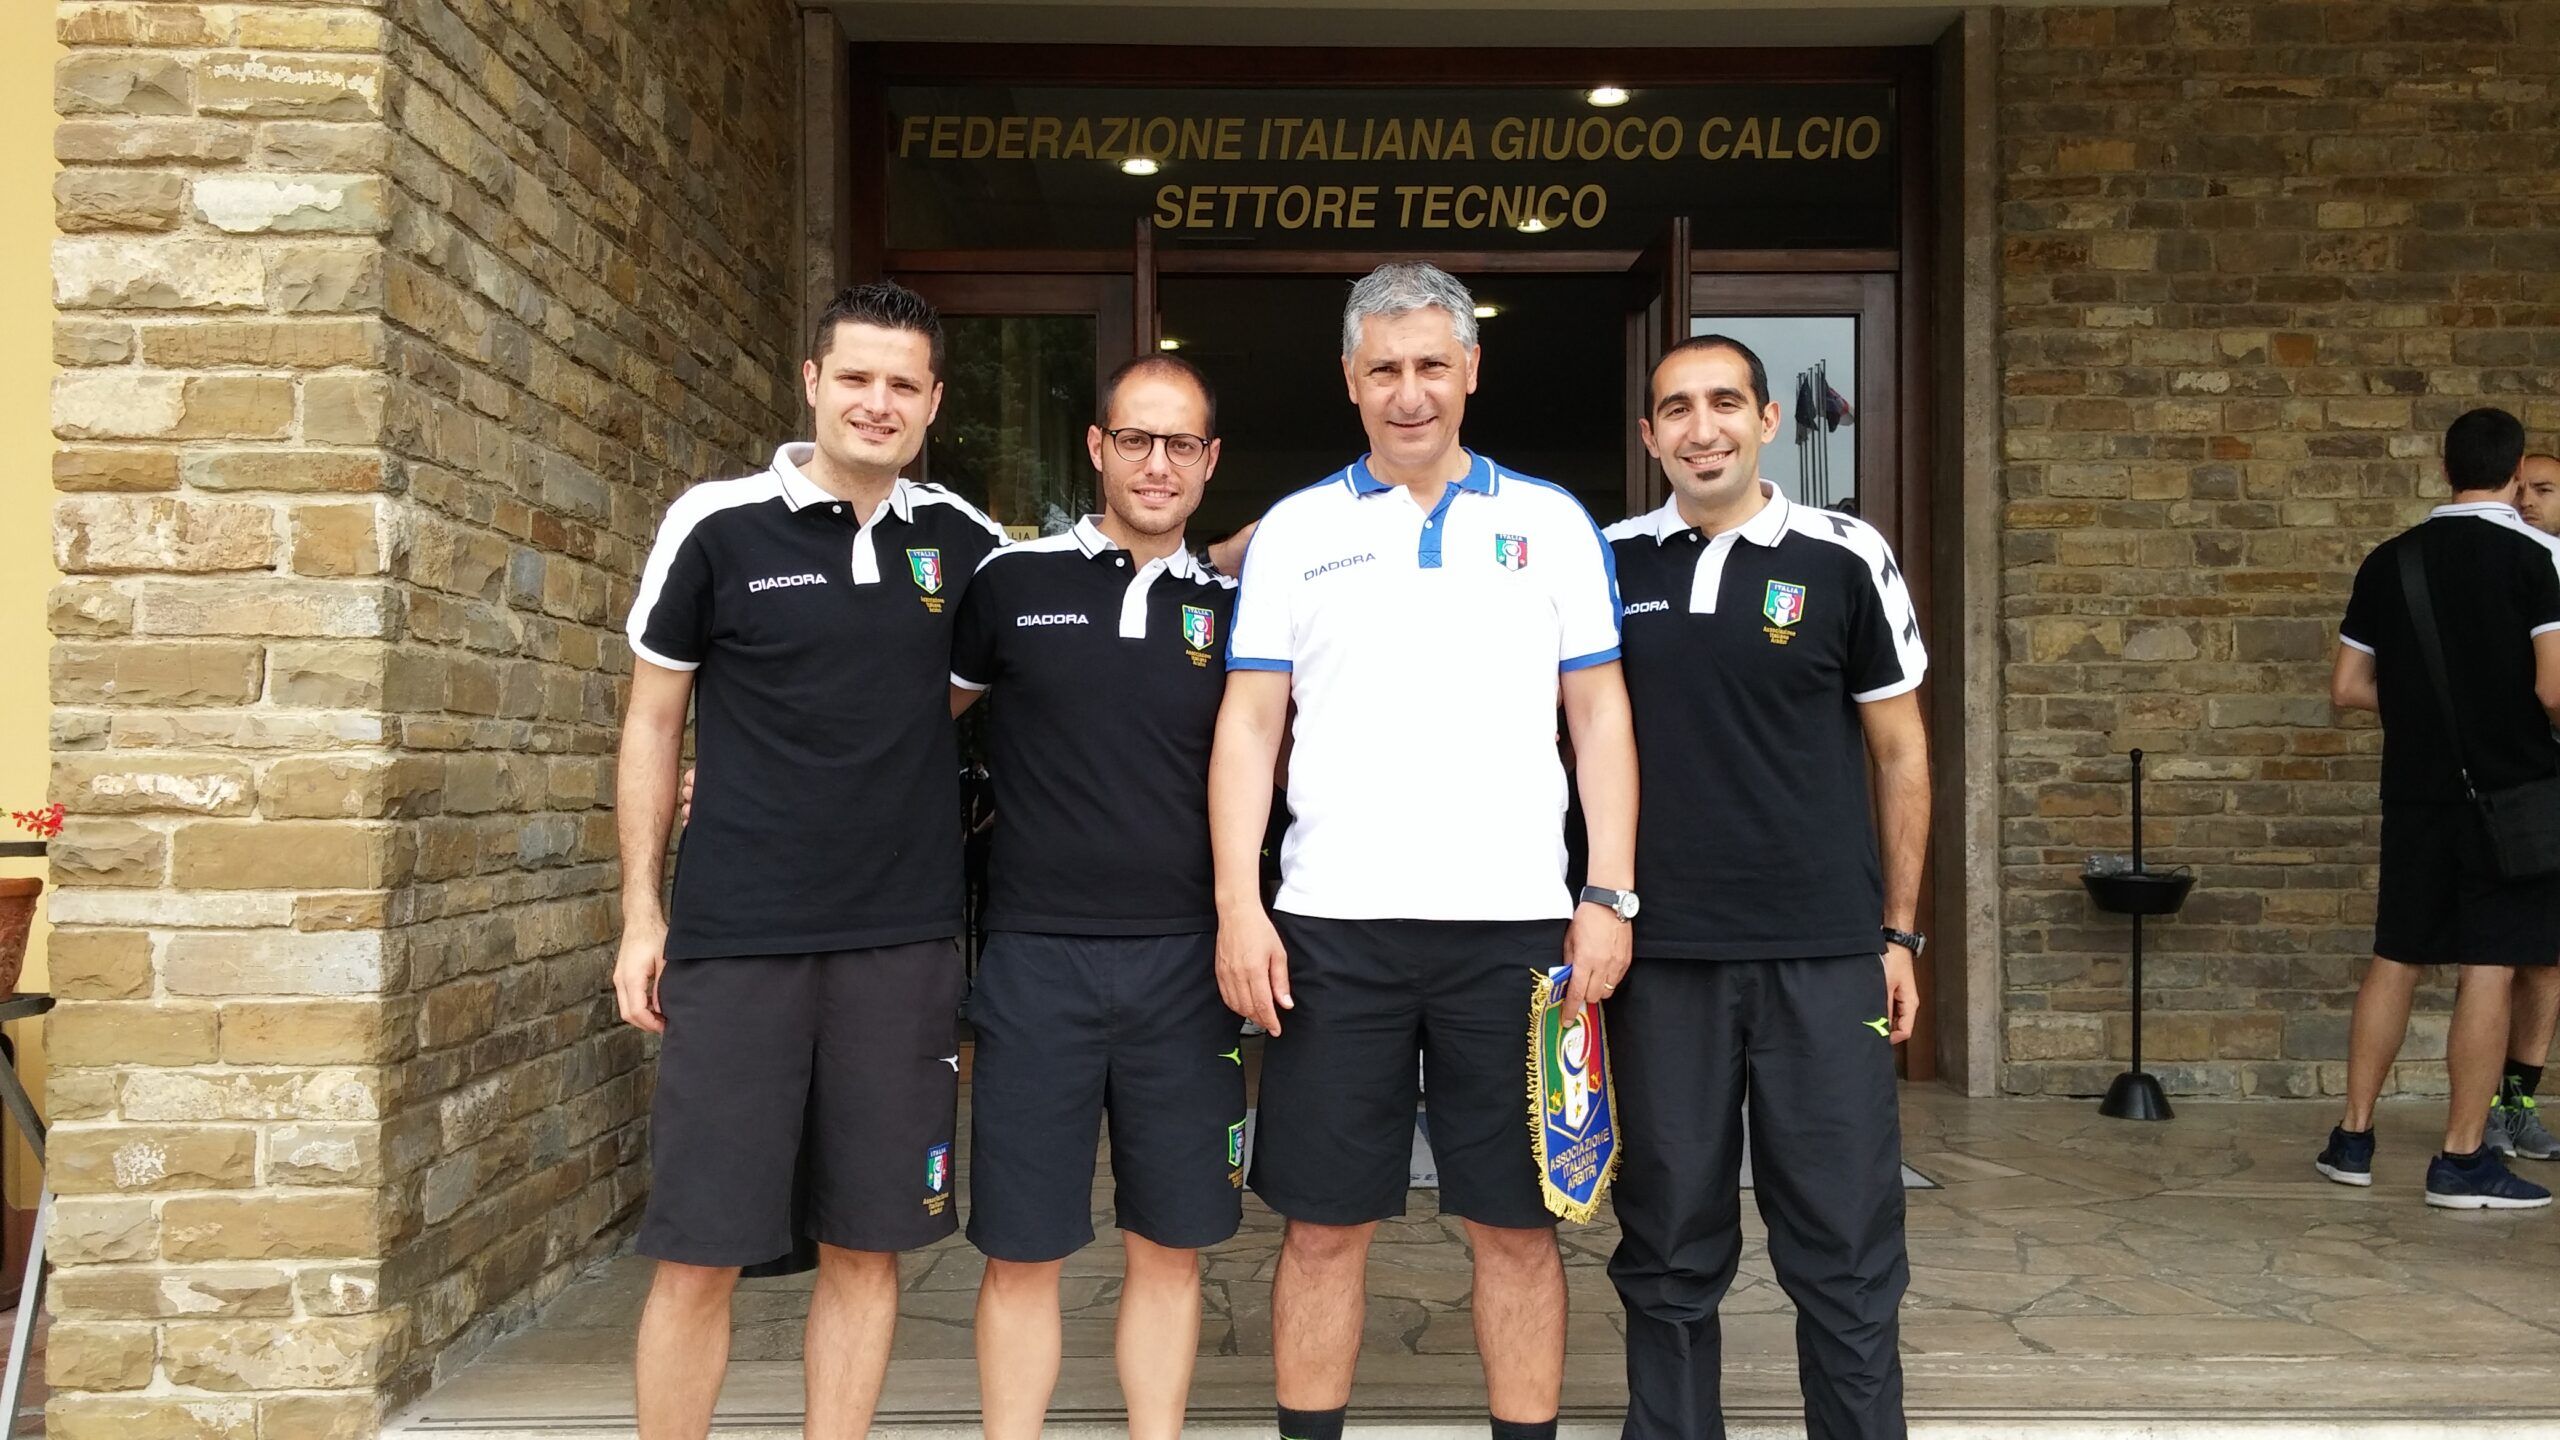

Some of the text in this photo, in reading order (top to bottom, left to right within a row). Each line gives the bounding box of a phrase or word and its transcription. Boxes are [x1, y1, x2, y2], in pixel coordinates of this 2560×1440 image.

[899, 115, 1881, 161] FEDERAZIONE ITALIANA GIUOCO CALCIO
[1153, 184, 1607, 229] SETTORE TECNICO
[1012, 531, 1030, 541] LIA
[1304, 552, 1376, 581] DIADORA
[749, 573, 828, 593] DIADORA
[1774, 584, 1799, 594] ITALIA
[1017, 614, 1089, 627] DIADORA
[1622, 599, 1670, 617] ADORA
[1550, 1127, 1610, 1173] ASSOCIAZIONE
[1562, 1149, 1599, 1179] ITALIANA
[1567, 1164, 1597, 1192] ARBITRI
